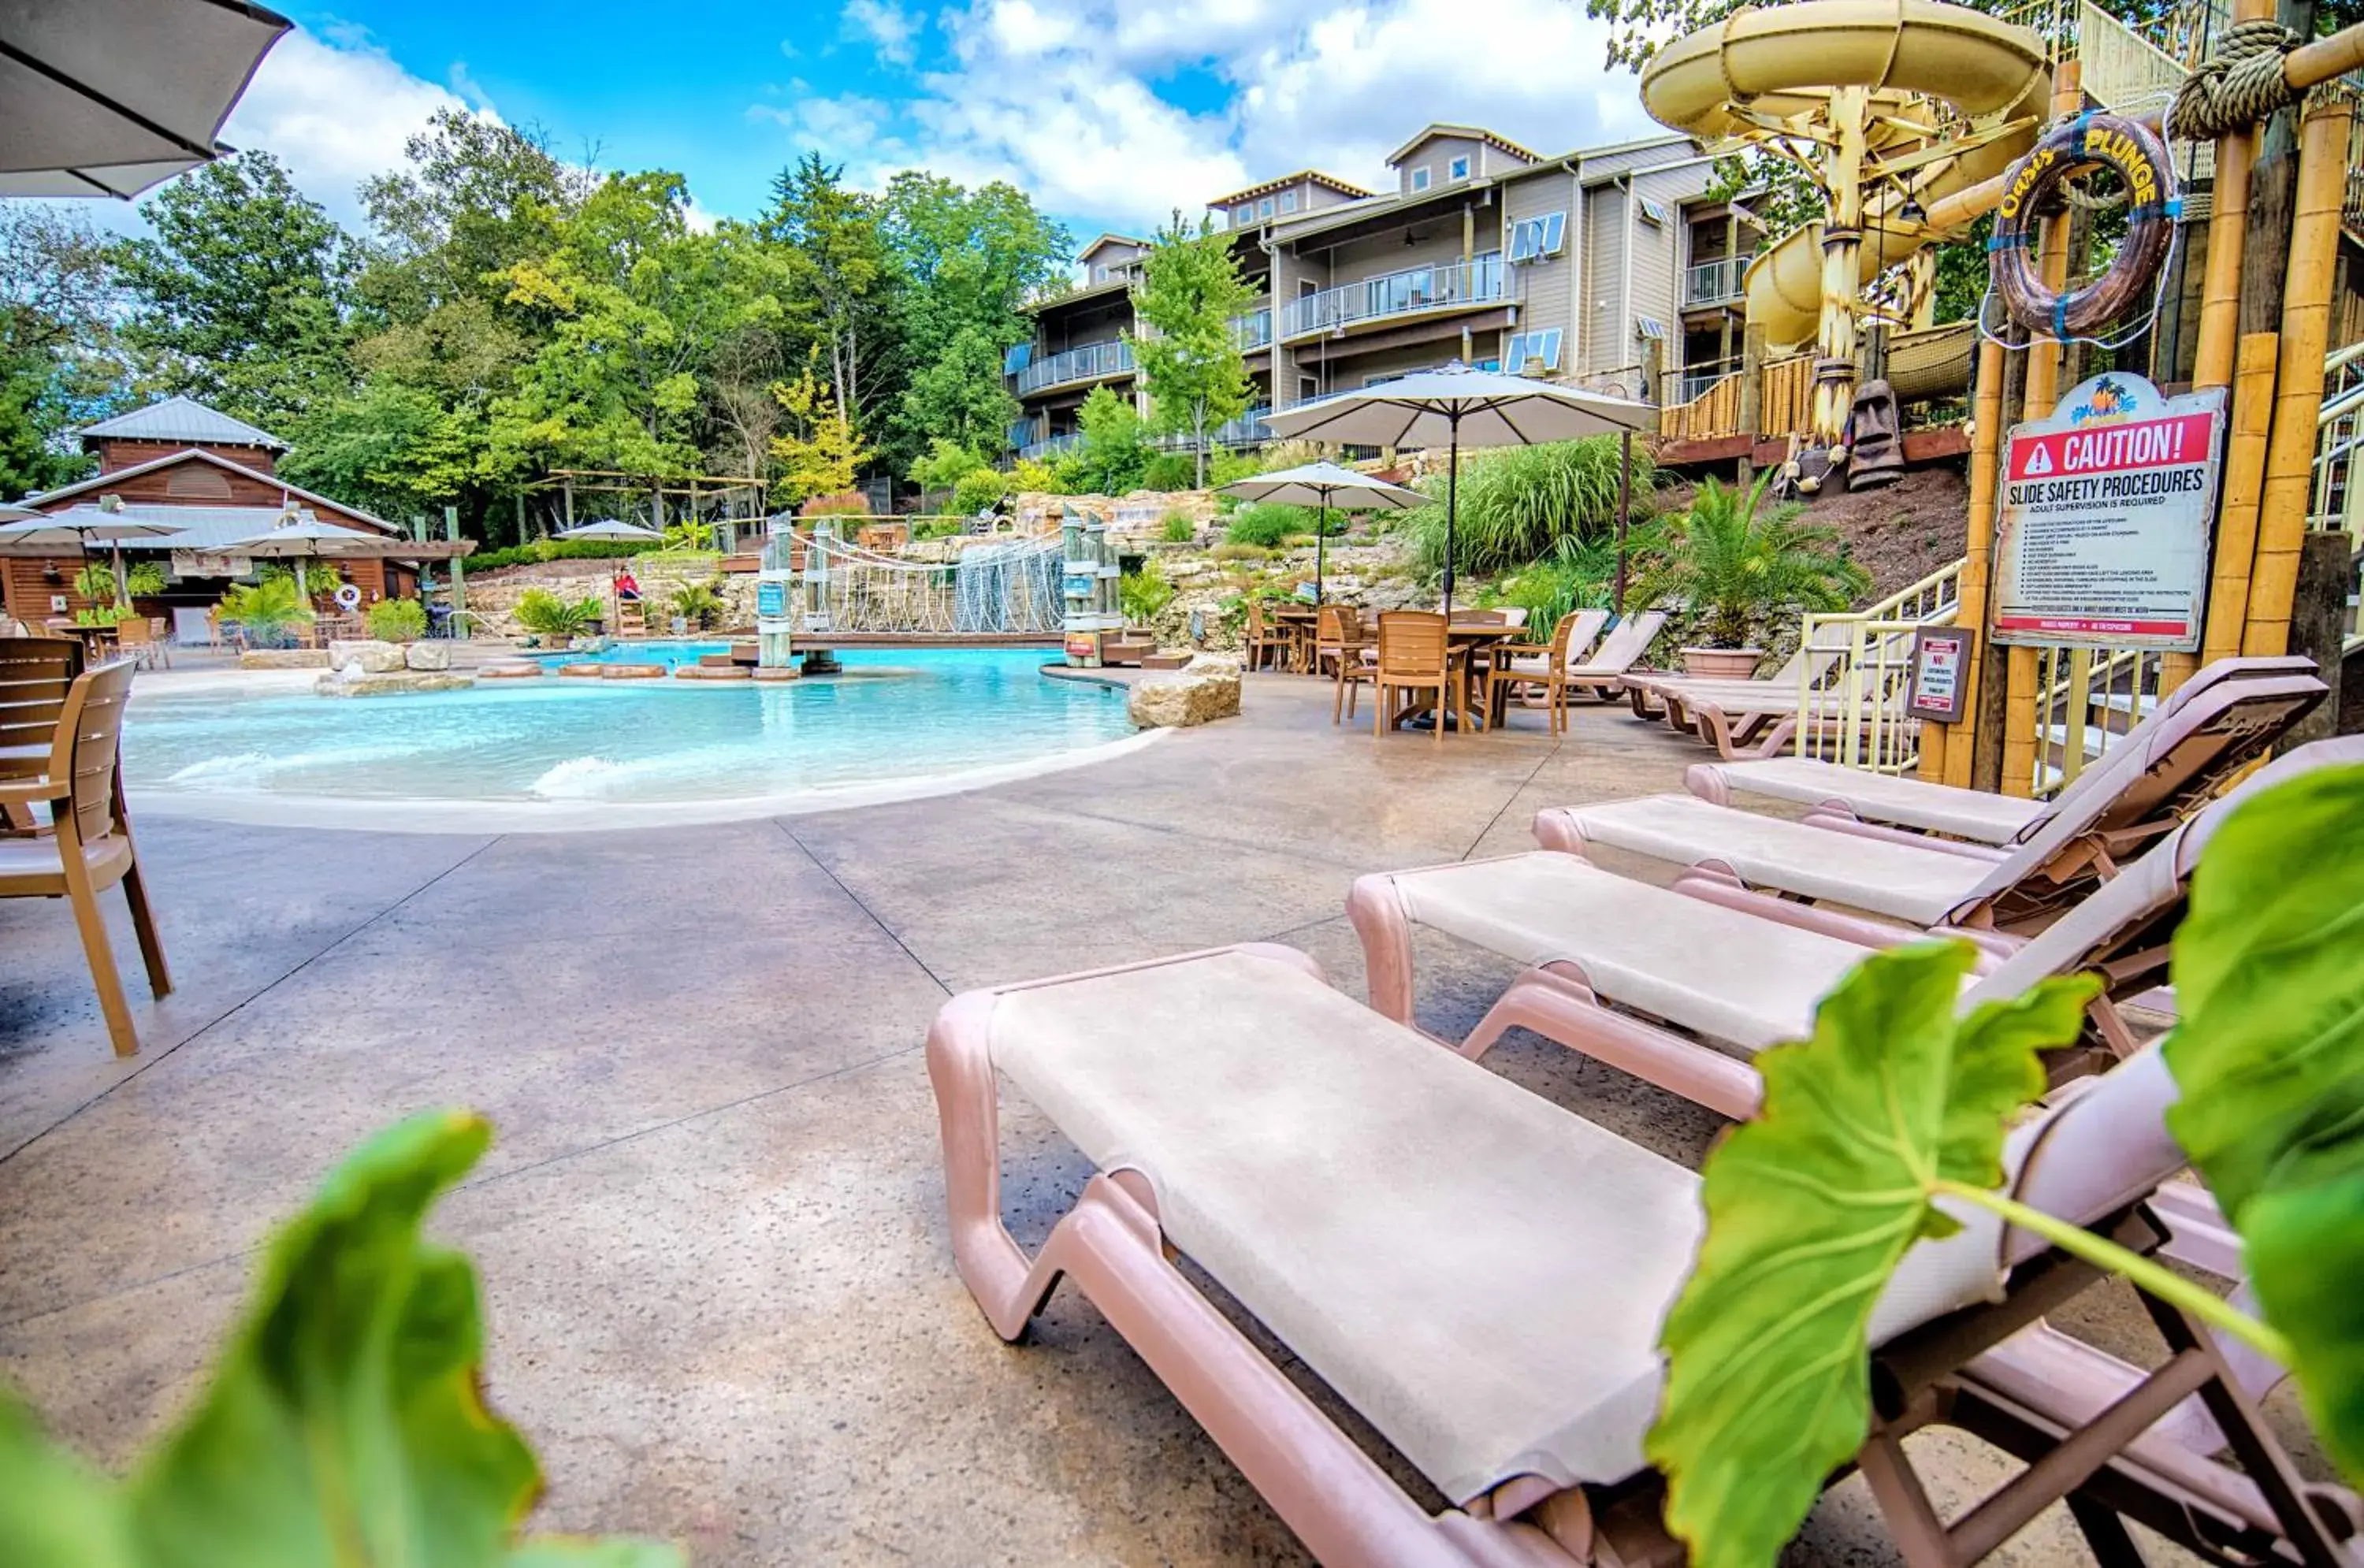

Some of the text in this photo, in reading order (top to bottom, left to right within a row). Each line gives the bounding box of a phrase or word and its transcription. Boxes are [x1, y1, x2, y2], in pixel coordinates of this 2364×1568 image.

[2001, 128, 2157, 218] Oasis PLUNGE
[2065, 423, 2183, 470] CAUTION!
[2009, 469, 2204, 505] SLIDE SAFETY PROCEDURES
[2030, 496, 2166, 513] ADULT SUPERVISION IS REQUIRED
